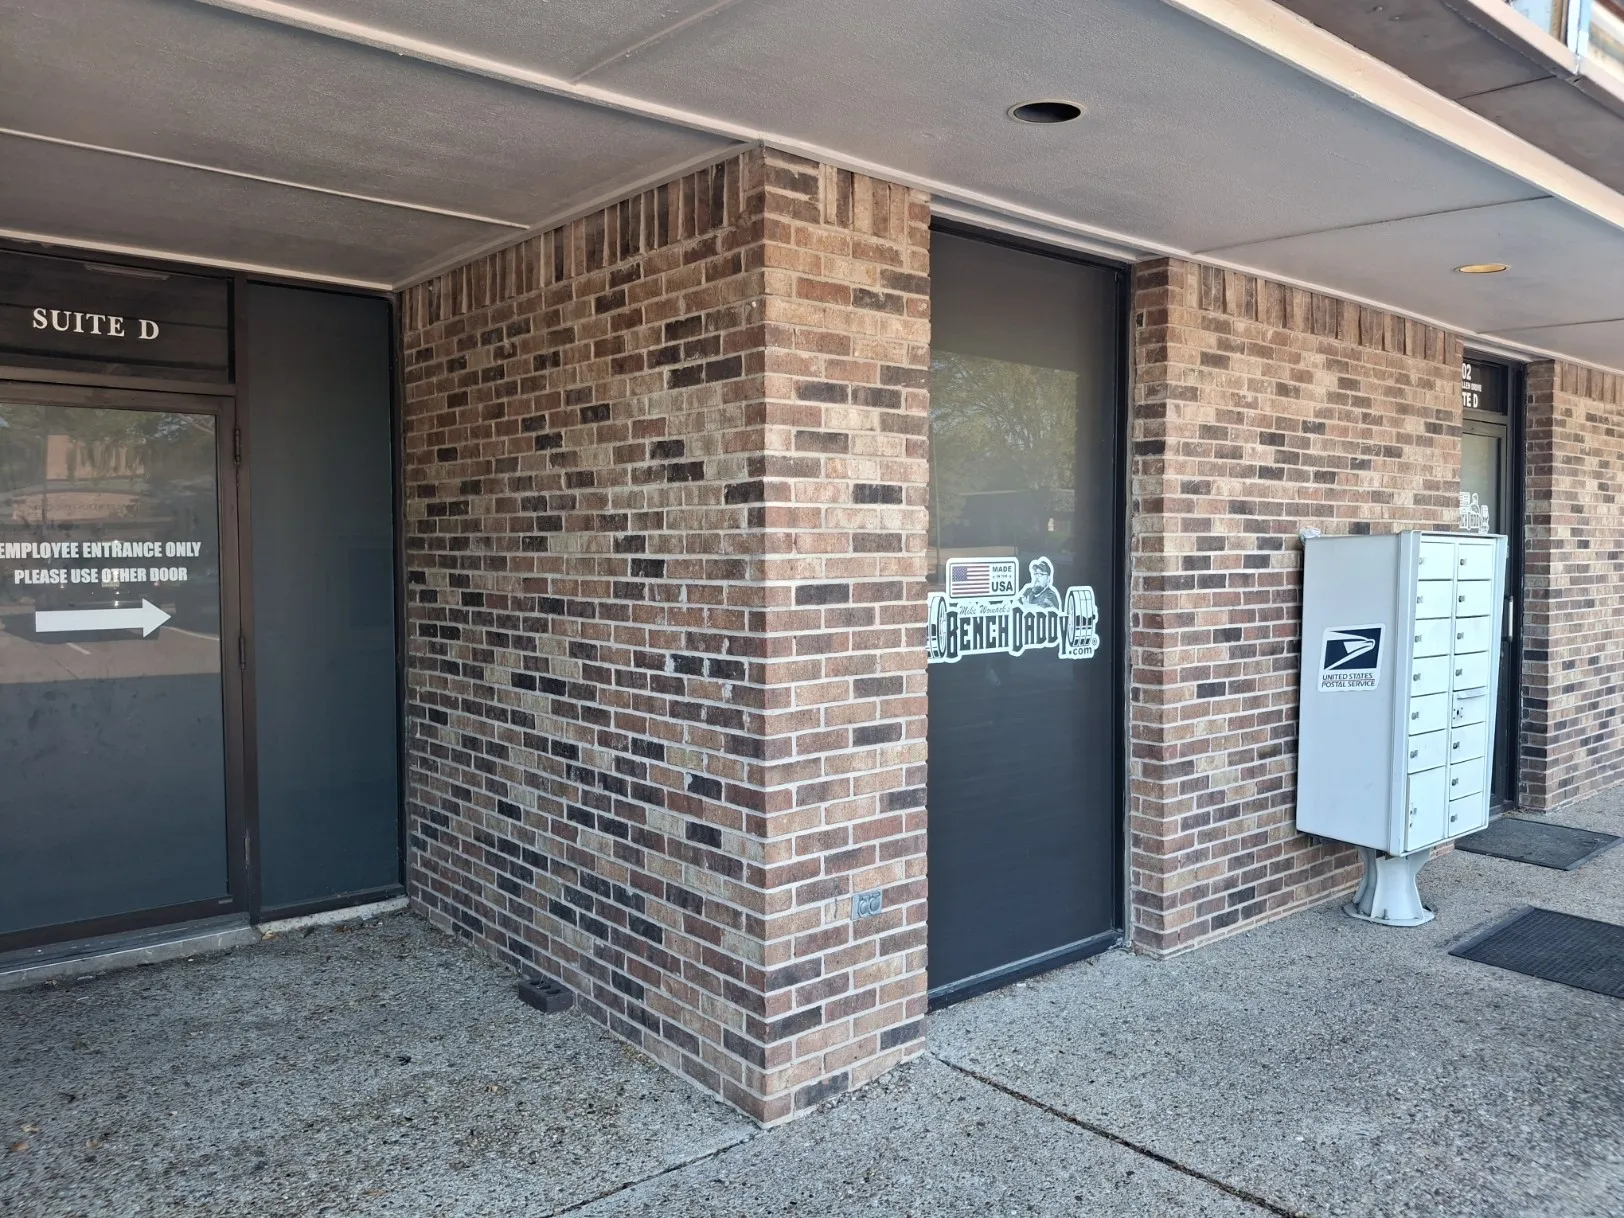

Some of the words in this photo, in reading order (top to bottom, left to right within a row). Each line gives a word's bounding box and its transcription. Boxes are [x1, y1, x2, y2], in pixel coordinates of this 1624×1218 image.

[33, 307, 125, 337] SUITE
[138, 319, 160, 340] D
[1473, 393, 1479, 408] D
[0, 542, 80, 559] EMPLOYEE
[82, 542, 163, 558] ENTRANCE
[165, 541, 202, 558] ONLY
[992, 565, 1013, 573] MADE
[14, 569, 68, 585] PLEASE
[70, 568, 99, 584] USE
[101, 567, 147, 583] OTHER
[150, 567, 188, 582] DOOR
[991, 581, 1014, 593] USA
[946, 611, 1009, 658] BENCH
[1069, 646, 1092, 656] .com
[1322, 673, 1348, 681] UNITED
[1349, 672, 1374, 680] STATES
[1321, 680, 1347, 688] POSTAL
[1348, 680, 1375, 688] SERVICE
